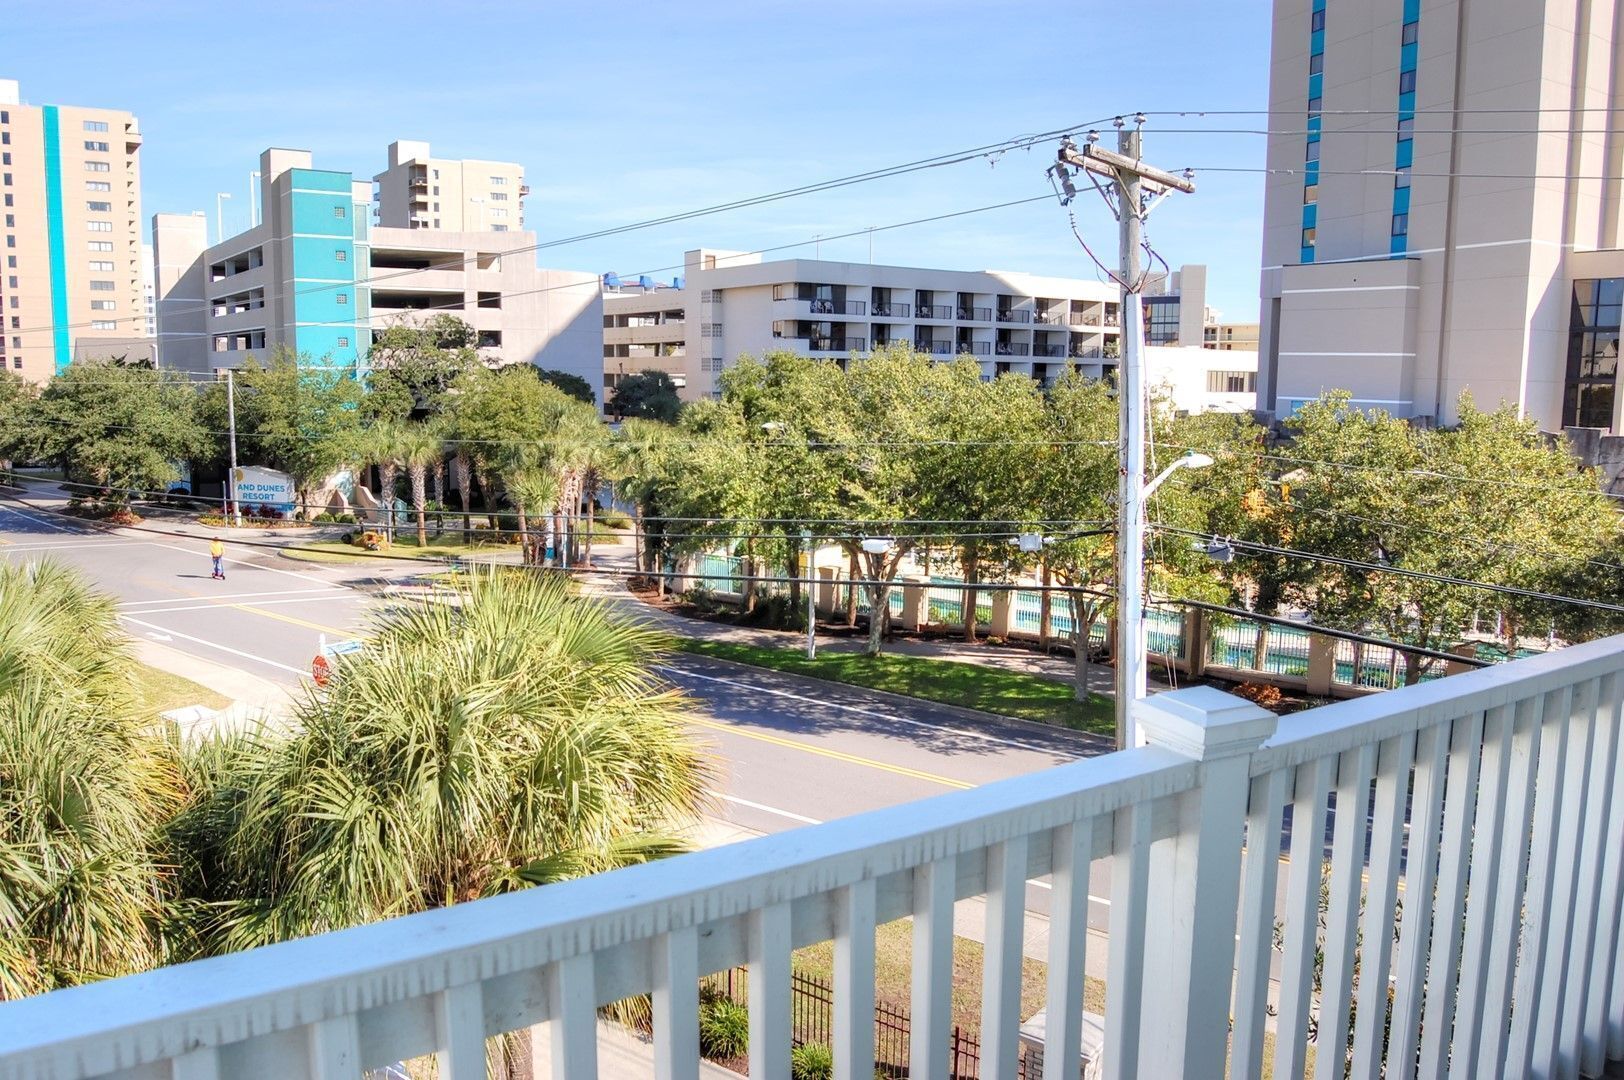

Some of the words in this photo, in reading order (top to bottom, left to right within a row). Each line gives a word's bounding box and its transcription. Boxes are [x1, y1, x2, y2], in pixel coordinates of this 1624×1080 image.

[237, 483, 255, 491] AND
[256, 484, 285, 493] DUNES
[242, 492, 275, 501] RESORT
